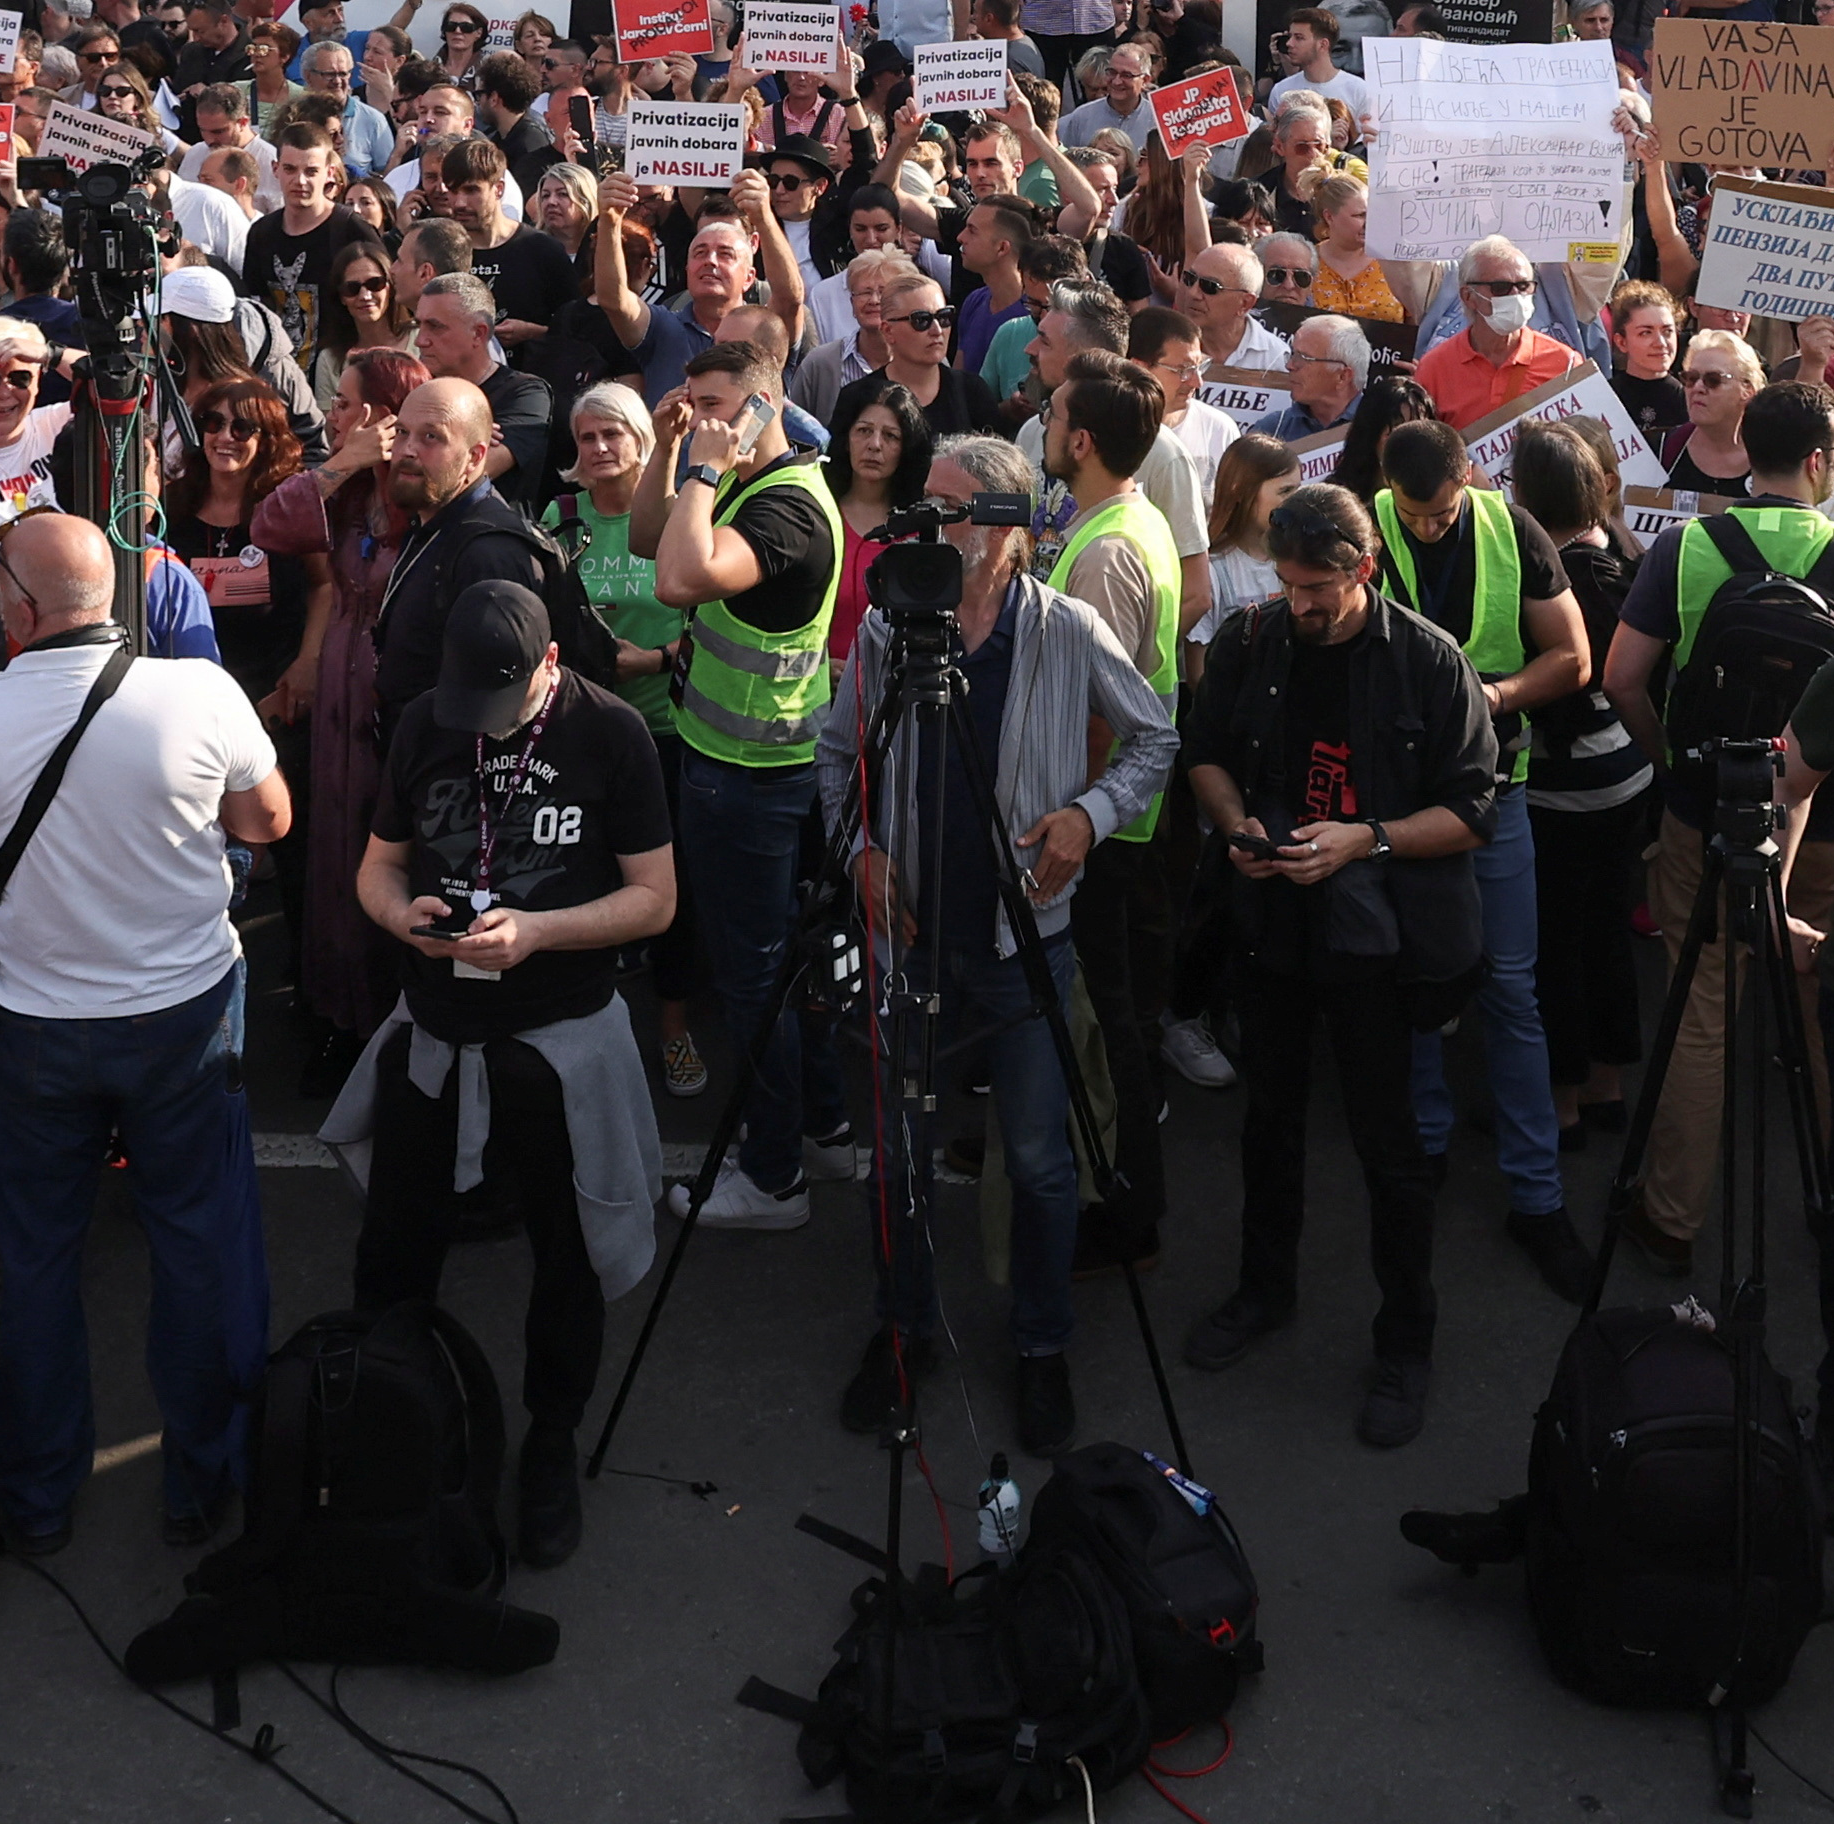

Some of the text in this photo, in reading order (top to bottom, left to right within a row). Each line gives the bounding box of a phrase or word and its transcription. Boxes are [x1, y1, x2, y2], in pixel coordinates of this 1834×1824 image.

[674, 19, 708, 34] Černi
[748, 10, 835, 27] Privatizacija
[747, 28, 834, 43] javnih dobara
[1703, 23, 1800, 57] VAŠA
[751, 48, 828, 64] je NASILJE
[918, 47, 1002, 65] Privatizacija
[1374, 45, 1506, 88] НАЈВЕЋА
[918, 68, 1002, 86] javnih dobara
[922, 88, 996, 108] je NASILJE
[1182, 87, 1200, 104] JP
[1377, 94, 1394, 122] И
[1498, 99, 1511, 119] У
[1519, 103, 1586, 119] НАШЕМ
[1720, 96, 1759, 125] JE
[52, 110, 147, 151] Privatizacija
[632, 111, 739, 131] Privatizacija
[47, 127, 90, 150] javnih
[92, 144, 133, 164] dobar
[630, 134, 737, 150] javnih dobara
[1459, 133, 1480, 150] ЈЕ
[1678, 125, 1812, 163] GOTOVA
[635, 160, 730, 178] je NASILJE
[1376, 170, 1389, 189] И
[1712, 224, 1810, 259] ПЕНЗИЈА
[1746, 261, 1791, 285] ДВА
[532, 805, 584, 846] 02
